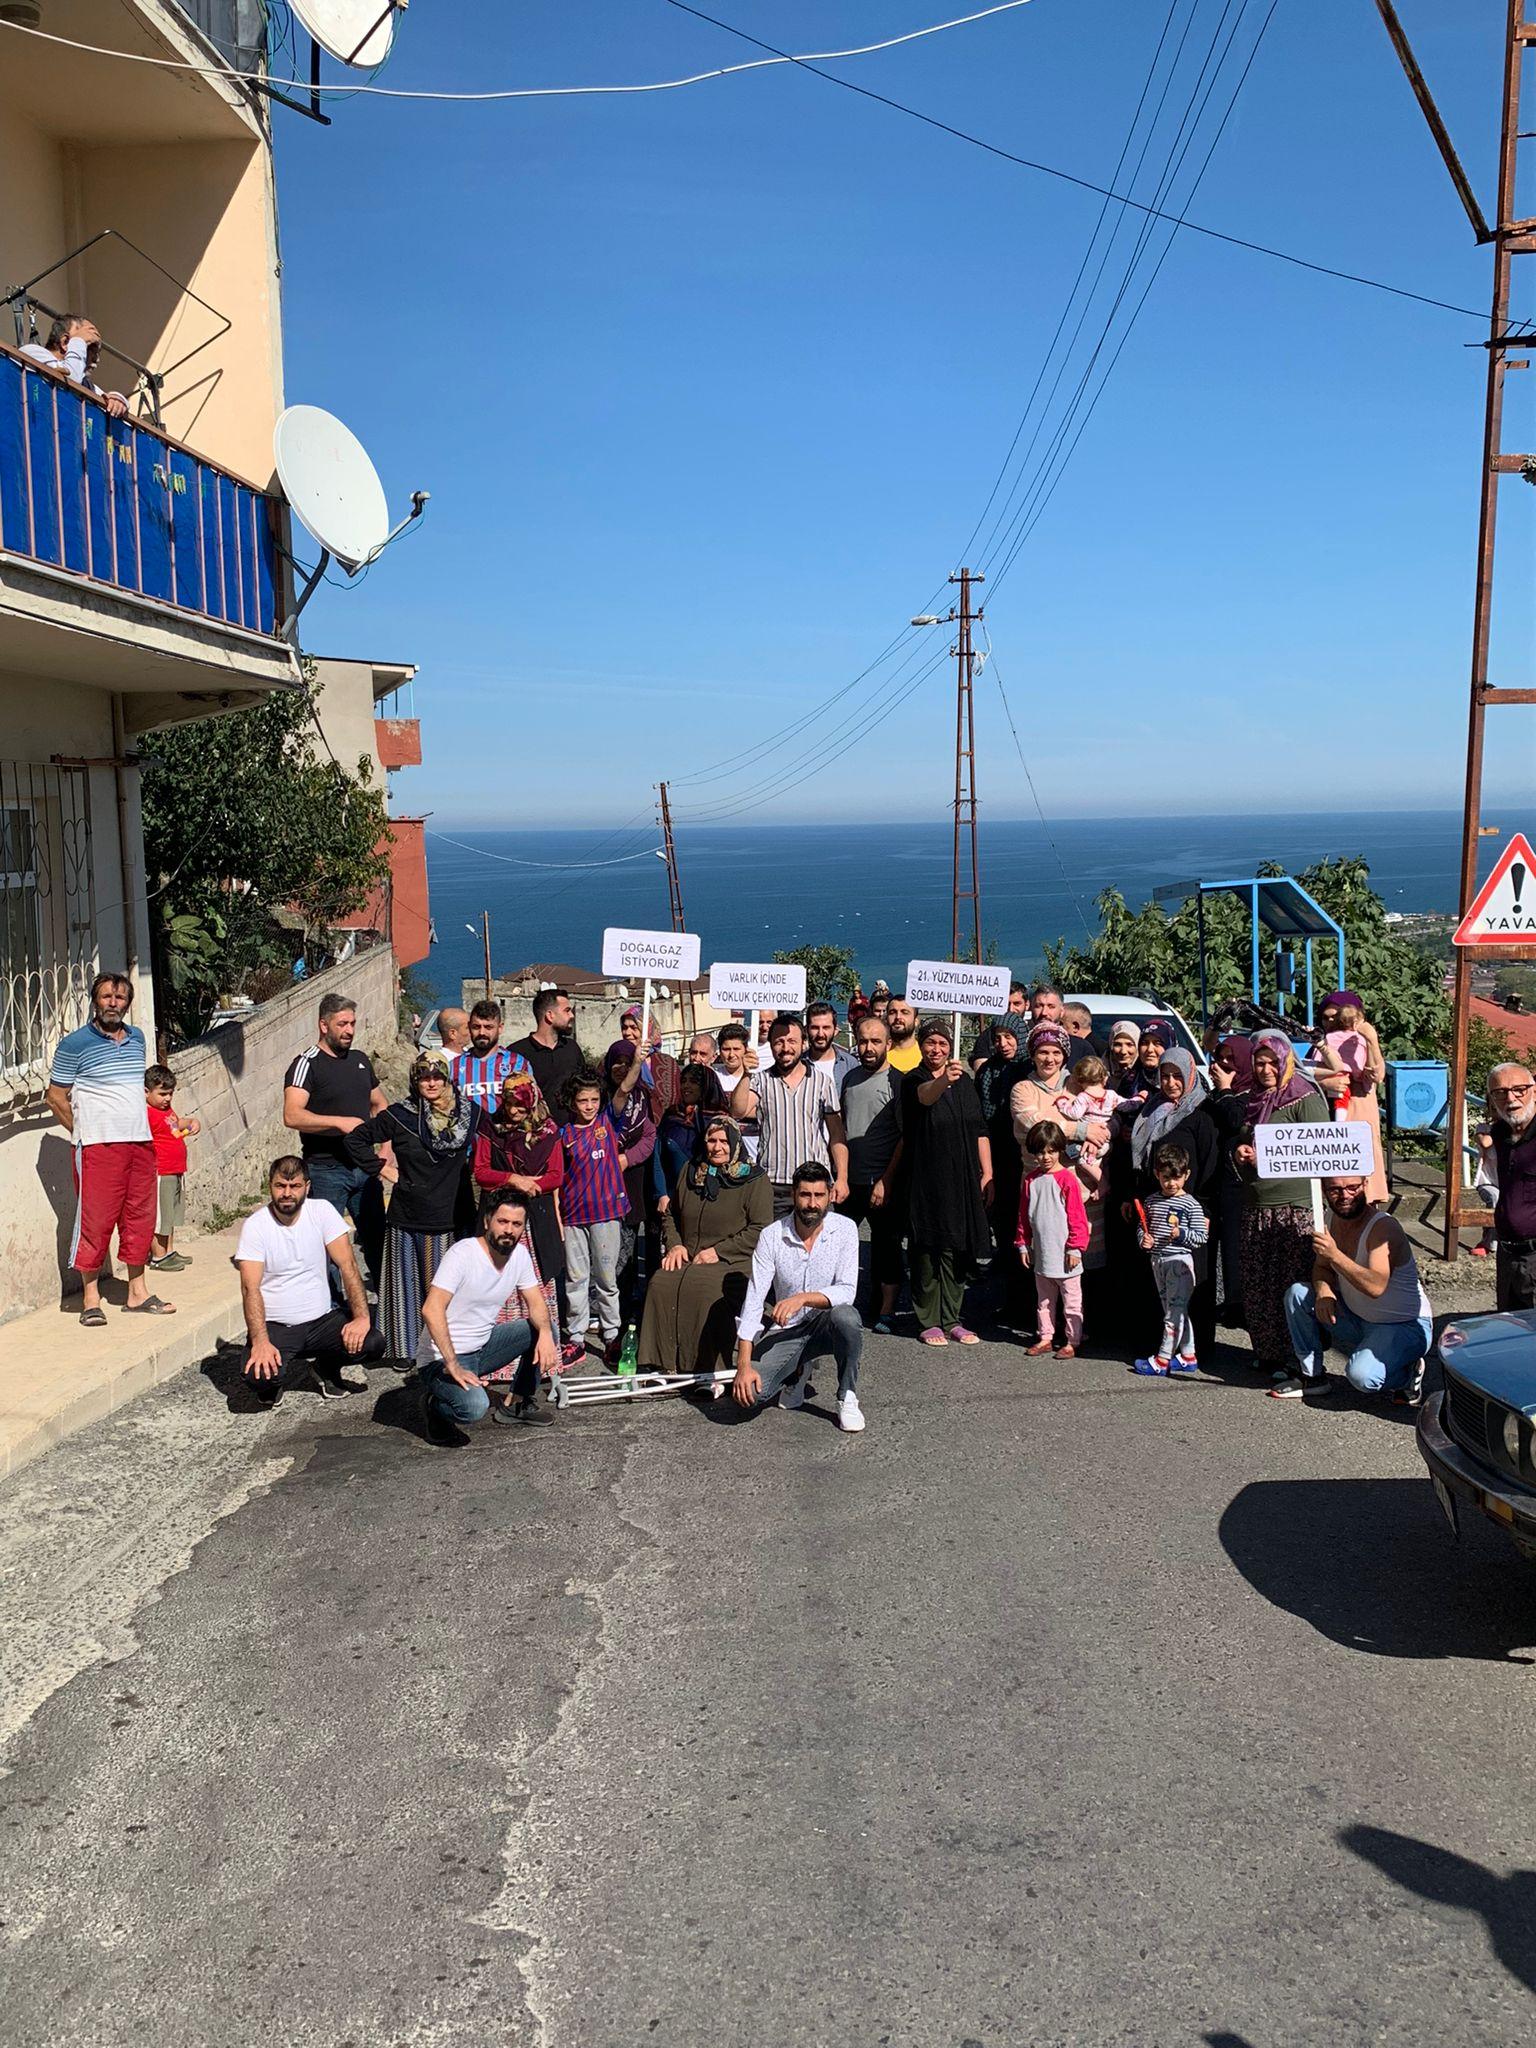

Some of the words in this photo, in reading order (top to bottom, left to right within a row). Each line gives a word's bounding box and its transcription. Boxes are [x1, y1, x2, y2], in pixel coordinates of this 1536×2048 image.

[1486, 917, 1536, 930] YAVA
[621, 954, 680, 969] İSTİYORUZ
[729, 972, 758, 985] VARLIK
[760, 970, 787, 986] İÇİNDE
[917, 970, 930, 982] 21.
[932, 969, 974, 986] YÜZYILDA
[975, 974, 1000, 988] HALA
[716, 991, 750, 1002] YOKLUK
[752, 989, 799, 1005] ÇEKİYORUZ
[910, 989, 937, 1001] SOBA
[937, 991, 1004, 1008] KULLANIYORUZ
[1275, 1129, 1293, 1140] OY
[1297, 1127, 1348, 1140] ZAMANI
[1265, 1143, 1361, 1157] HATIRLANMAK
[1269, 1157, 1359, 1172] İSTEMİYORUZ
